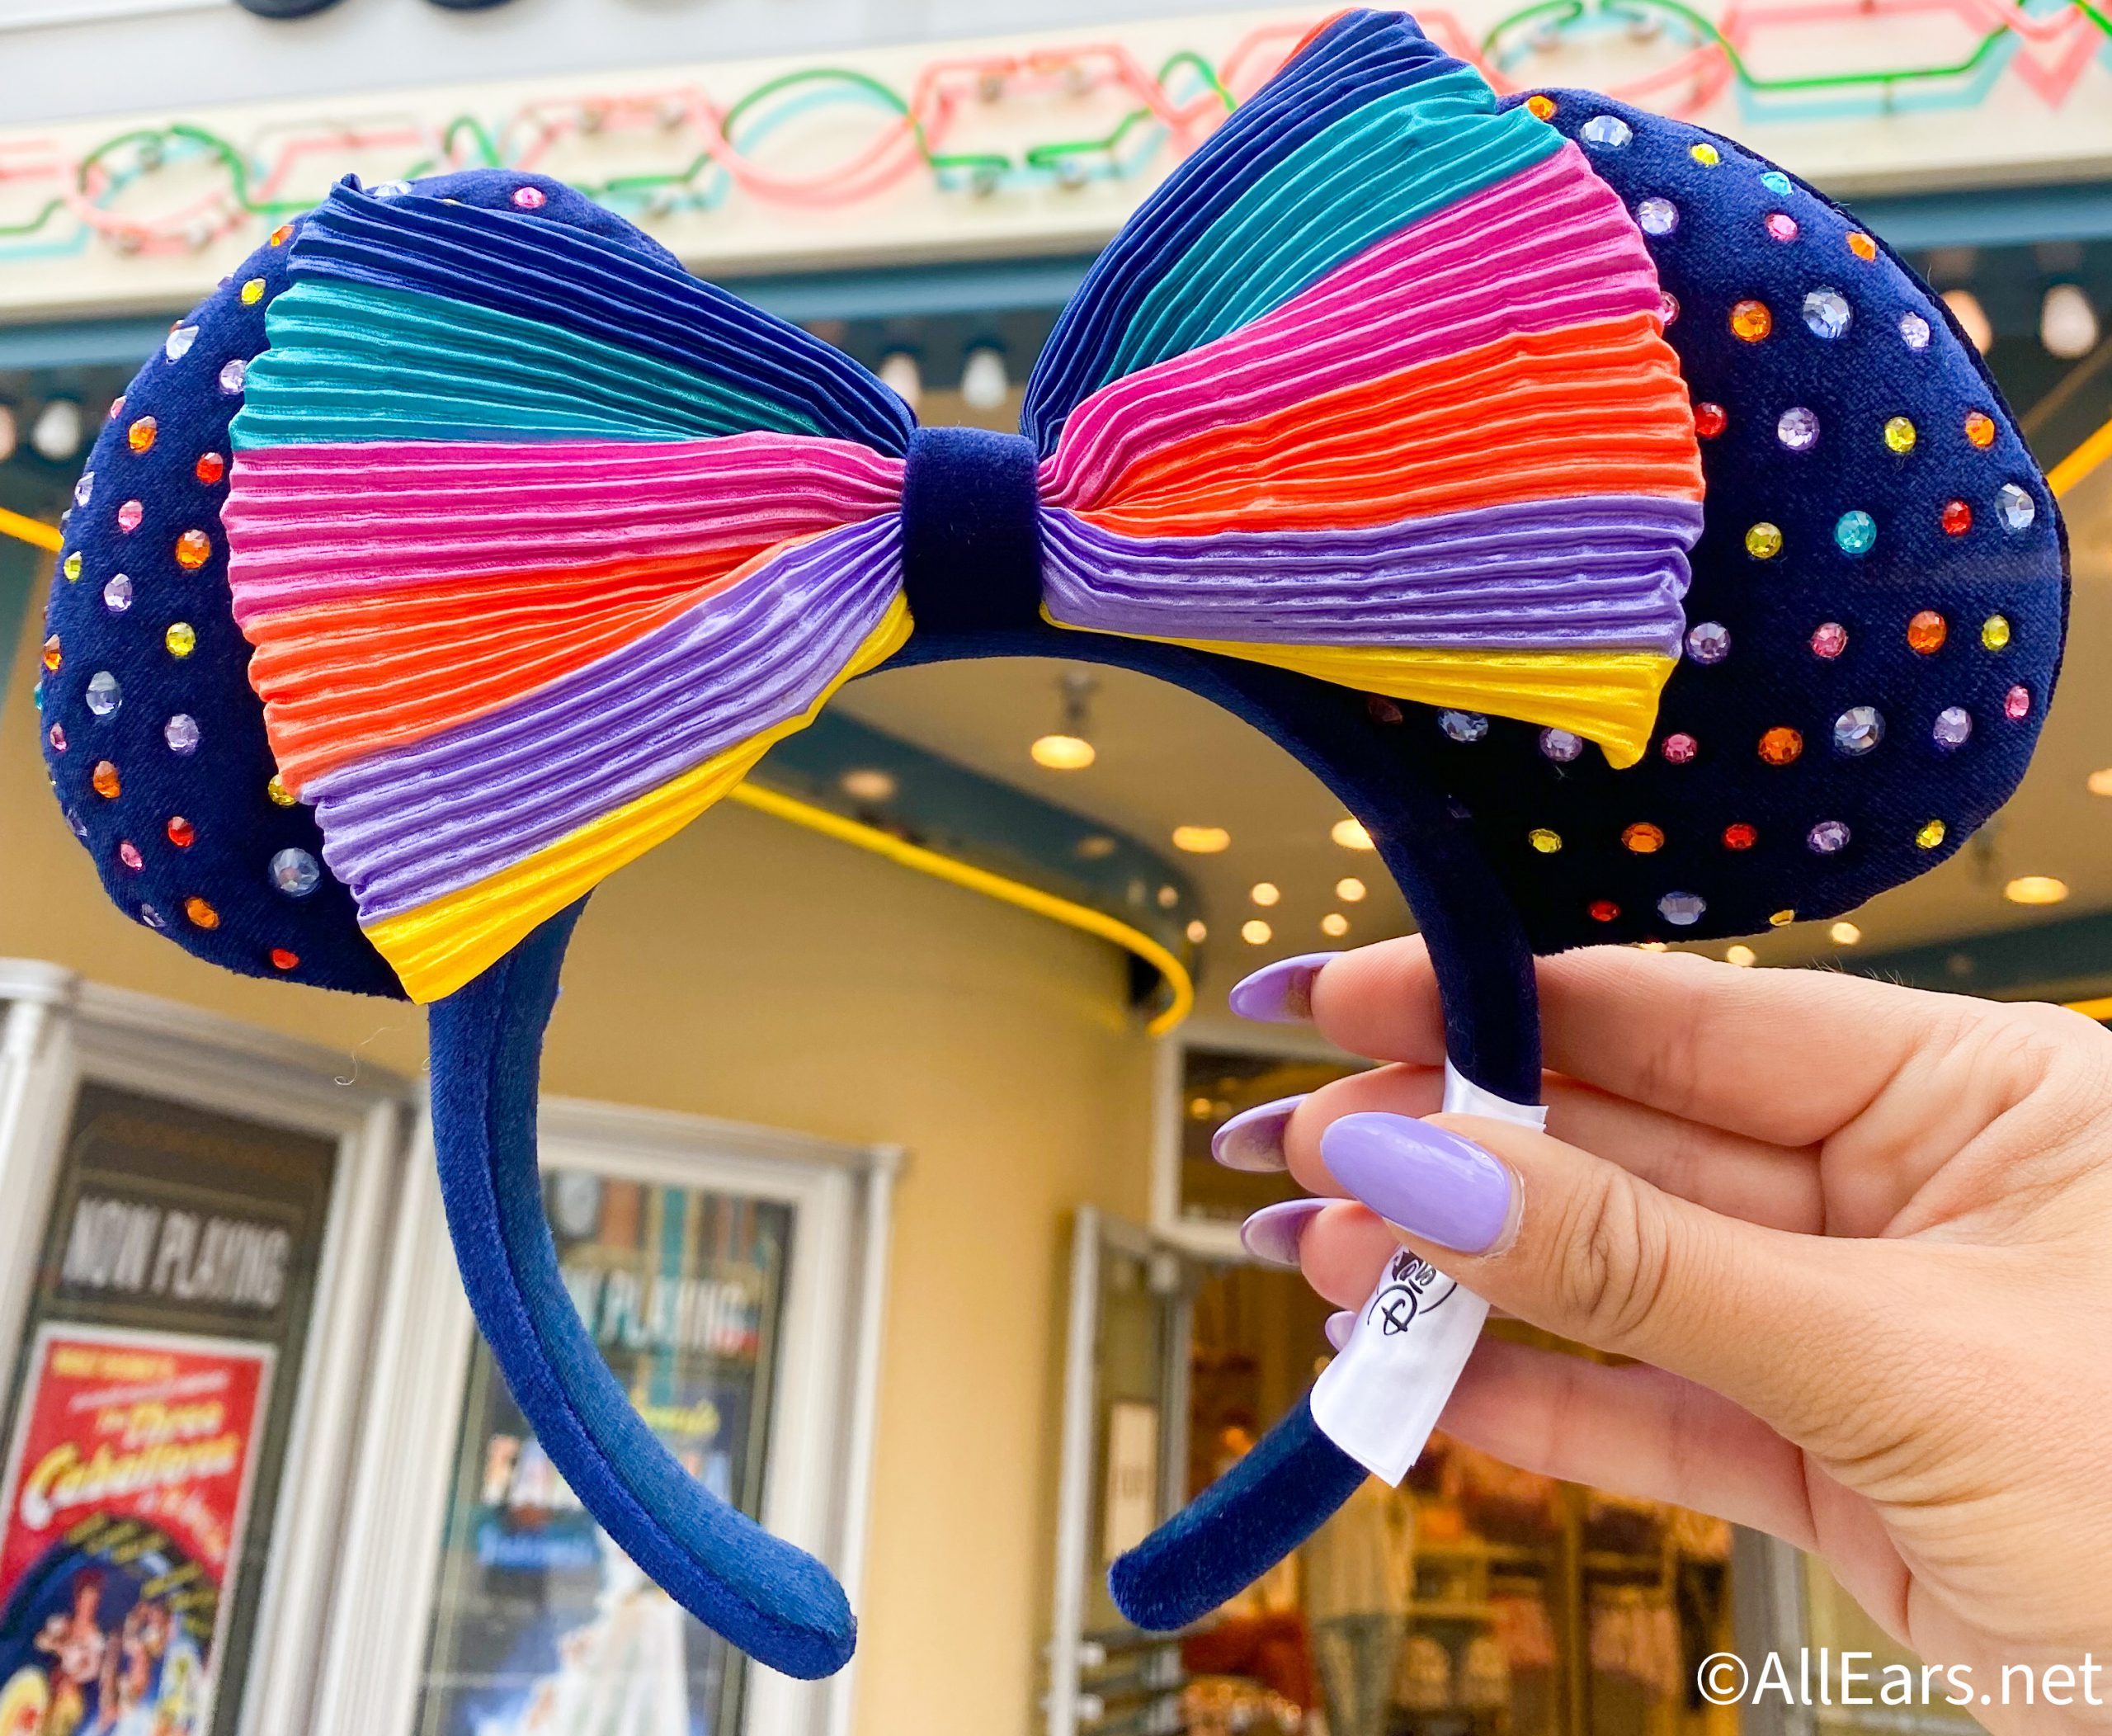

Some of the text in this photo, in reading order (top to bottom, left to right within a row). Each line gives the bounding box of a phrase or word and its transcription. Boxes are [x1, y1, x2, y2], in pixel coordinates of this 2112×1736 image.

[62, 1196, 288, 1309] NOW PLAYING
[1367, 1260, 1437, 1336] Dis
